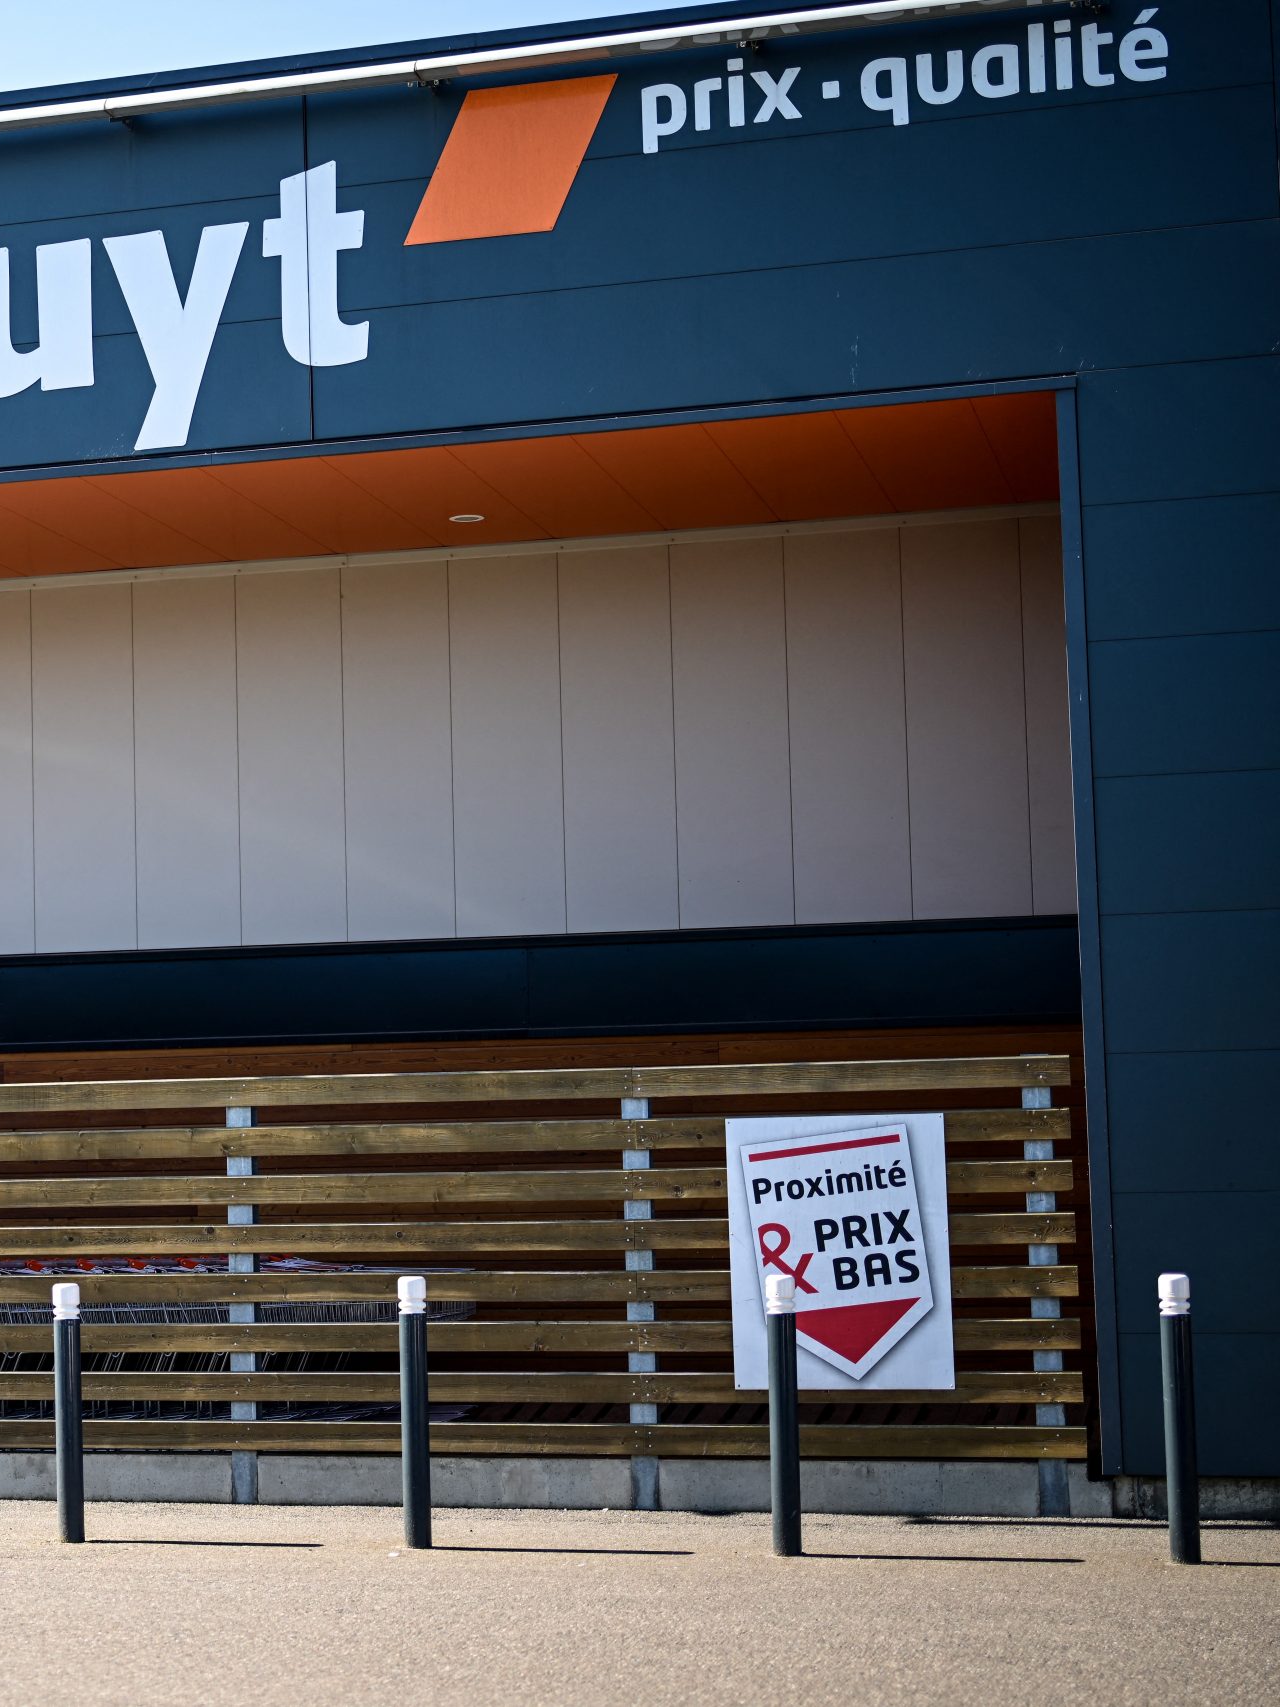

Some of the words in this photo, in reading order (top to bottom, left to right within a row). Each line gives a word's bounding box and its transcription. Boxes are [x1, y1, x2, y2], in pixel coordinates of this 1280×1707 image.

[641, 57, 803, 154] prix
[860, 7, 1168, 126] qualité
[751, 1159, 907, 1205] Proximité
[813, 1208, 915, 1253] PRIX
[832, 1249, 920, 1291] BAS
